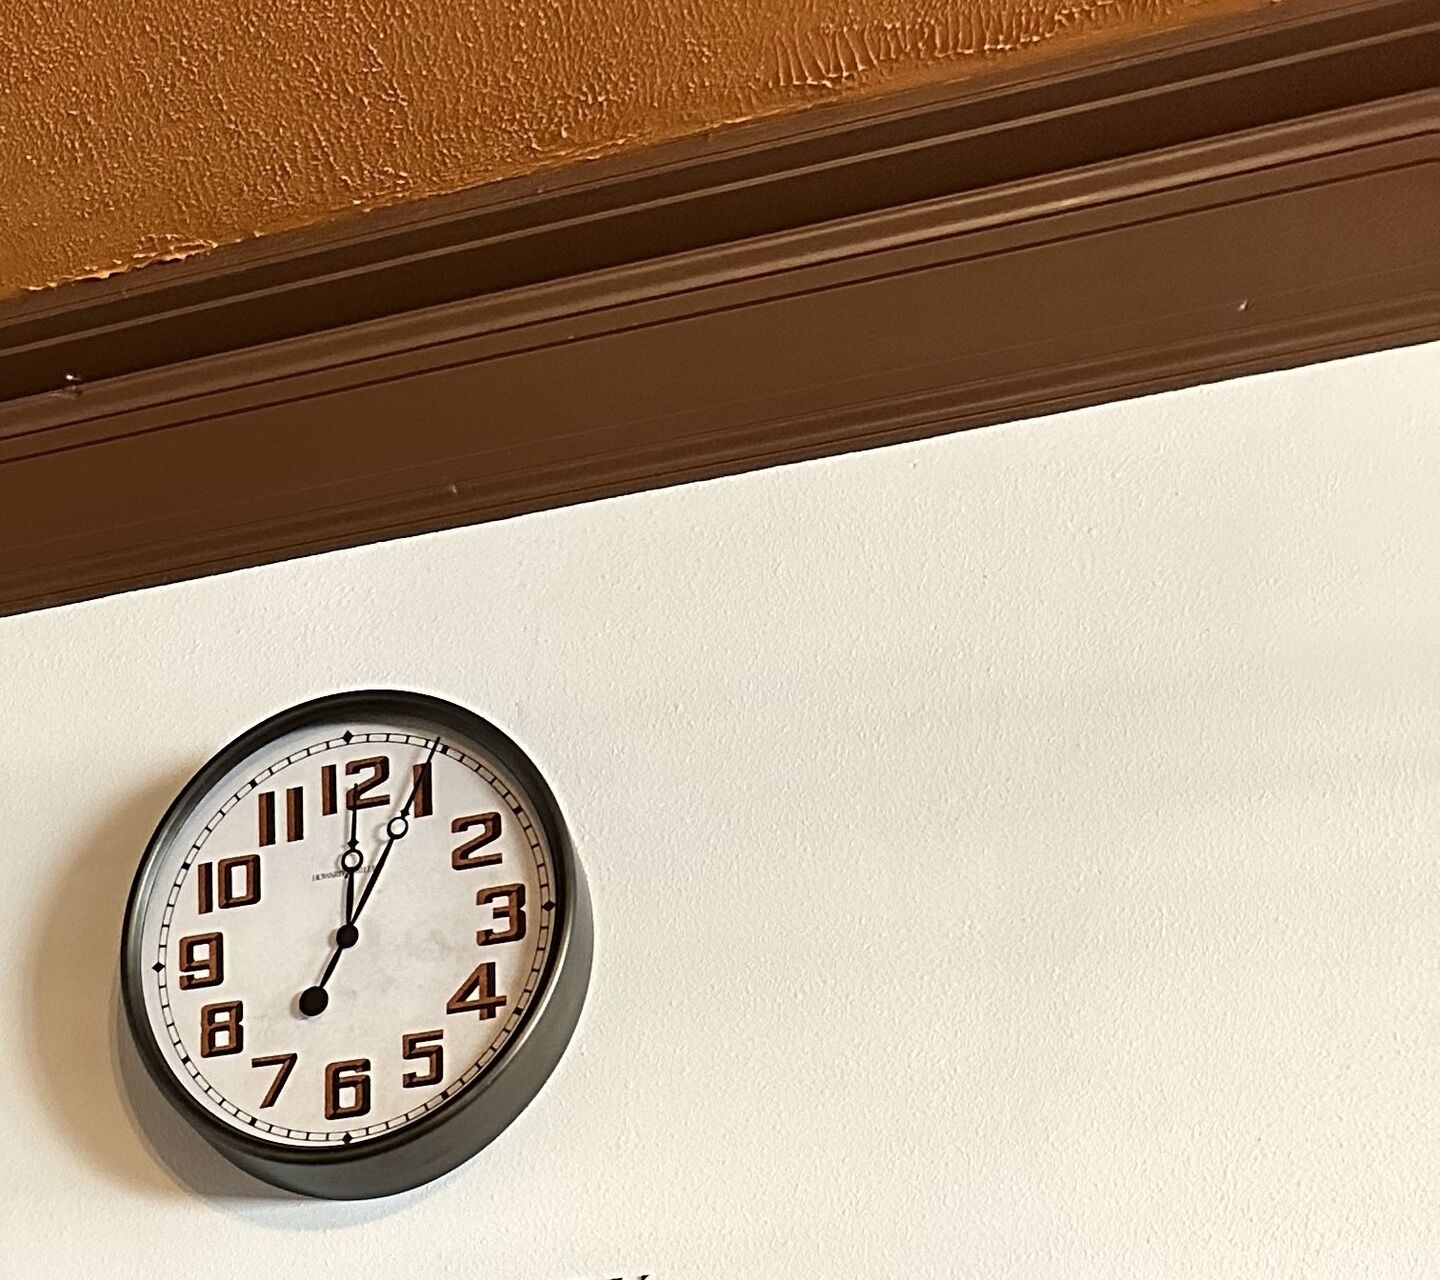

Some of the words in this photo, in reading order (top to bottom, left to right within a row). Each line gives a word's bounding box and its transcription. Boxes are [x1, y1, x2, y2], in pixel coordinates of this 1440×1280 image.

[321, 755, 391, 816] 12
[413, 762, 434, 818] 1
[258, 786, 305, 847] 11
[450, 811, 503, 871] 2
[197, 853, 262, 915] 10
[476, 883, 527, 947] 3
[178, 931, 224, 991] 9
[446, 961, 508, 1021] 4
[200, 1000, 244, 1058] 8
[402, 1029, 444, 1088] 5
[251, 1052, 298, 1110] 7
[324, 1058, 371, 1121] 6
